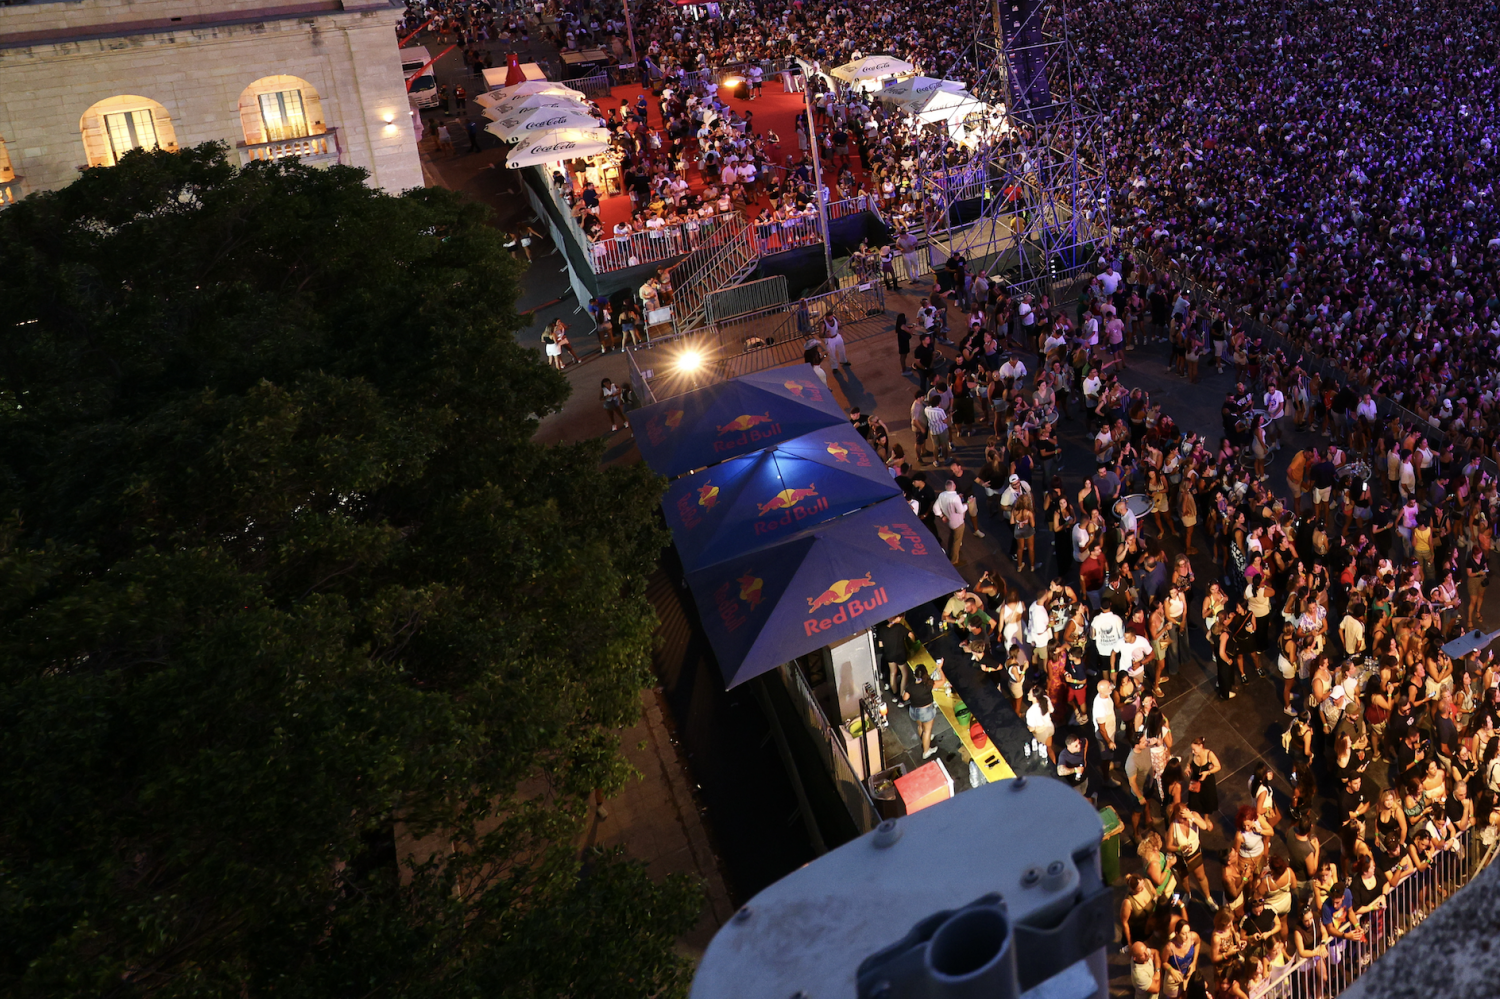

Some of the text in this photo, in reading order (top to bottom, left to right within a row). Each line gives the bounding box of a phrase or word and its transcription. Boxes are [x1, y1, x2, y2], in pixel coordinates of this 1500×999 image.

[713, 423, 782, 453] Red Bull
[754, 496, 829, 536] Red Bull
[904, 536, 928, 555] Red
[803, 586, 889, 637] Red Bull
